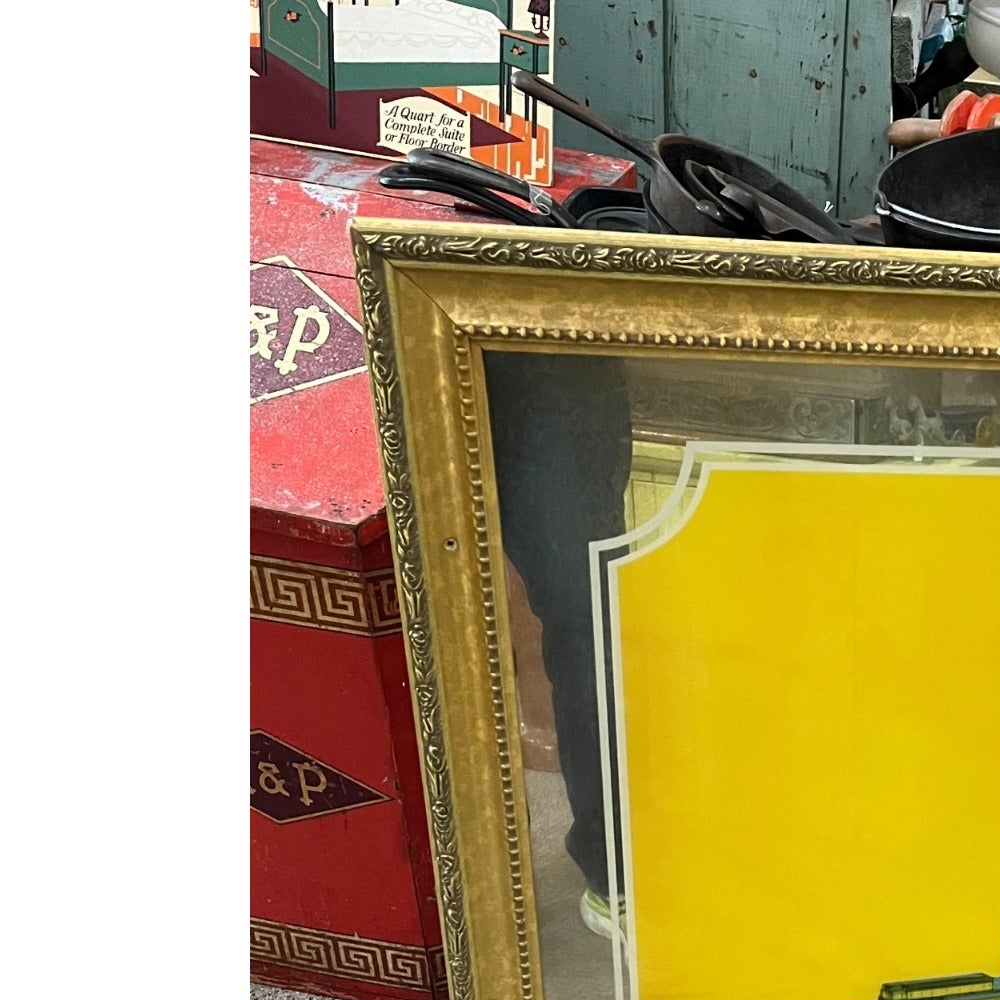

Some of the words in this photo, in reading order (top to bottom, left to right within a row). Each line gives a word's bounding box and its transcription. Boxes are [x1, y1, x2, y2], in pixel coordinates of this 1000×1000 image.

[385, 106, 399, 116] A
[400, 106, 434, 123] Quart
[435, 113, 456, 127] for
[456, 119, 465, 128] a
[384, 118, 436, 137] Complete
[438, 126, 466, 142] Suite
[384, 133, 398, 142] or
[398, 133, 428, 147] Floor
[430, 138, 466, 154] Border
